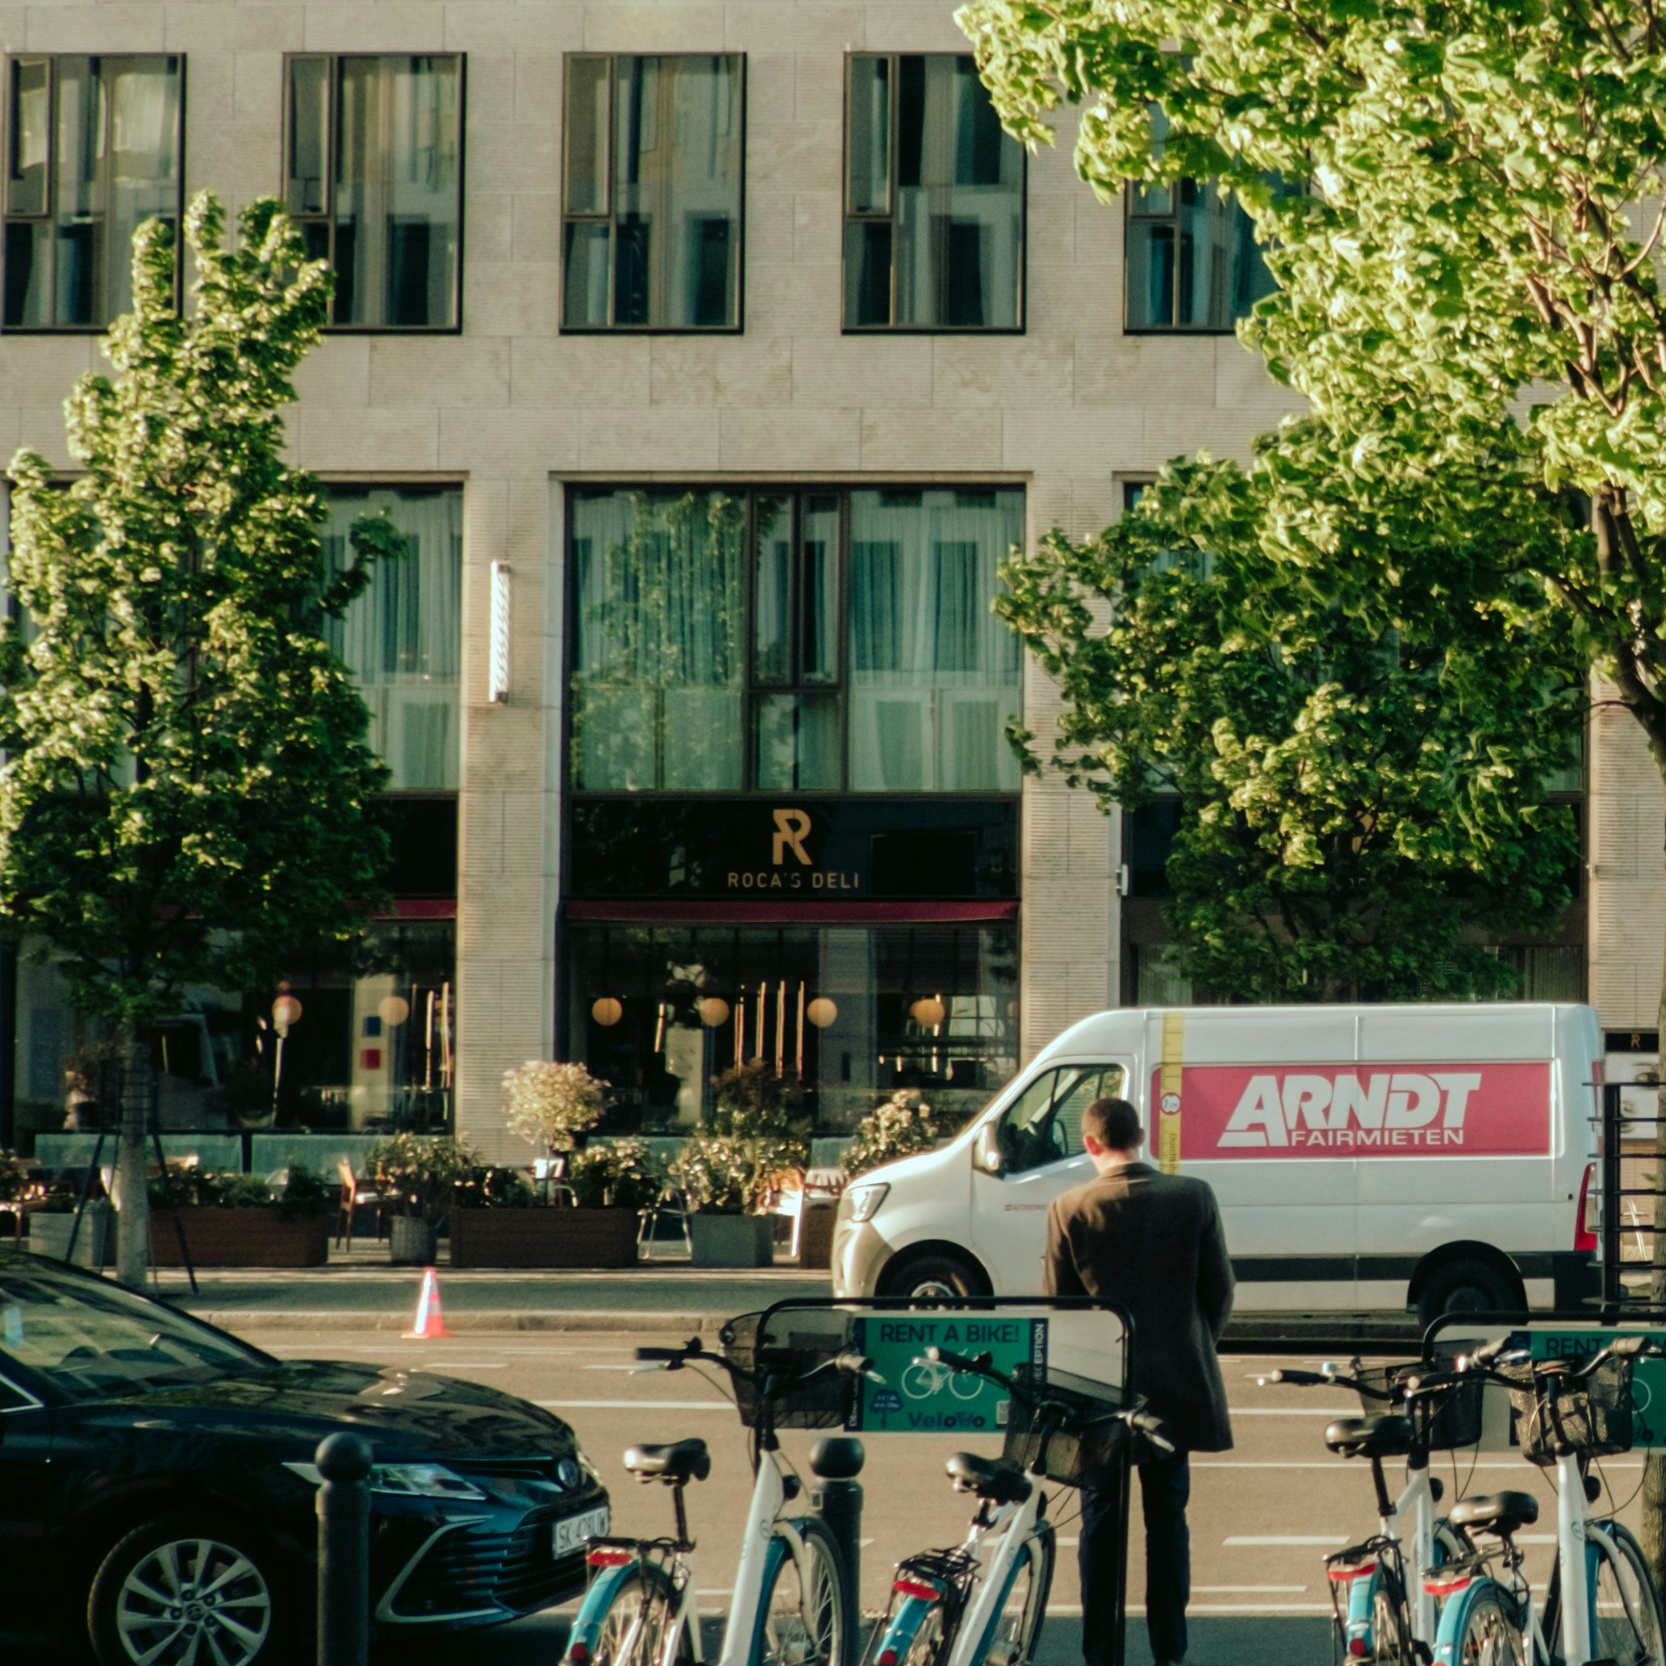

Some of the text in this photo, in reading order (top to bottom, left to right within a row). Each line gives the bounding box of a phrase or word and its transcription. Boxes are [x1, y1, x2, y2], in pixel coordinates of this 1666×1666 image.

[772, 808, 814, 865] R
[727, 872, 859, 889] ROCA'S DELI
[1217, 1073, 1482, 1148] ARNDT
[1291, 1129, 1464, 1147] FAIRMIETEN
[881, 1324, 1020, 1343] RENT A BIKE!
